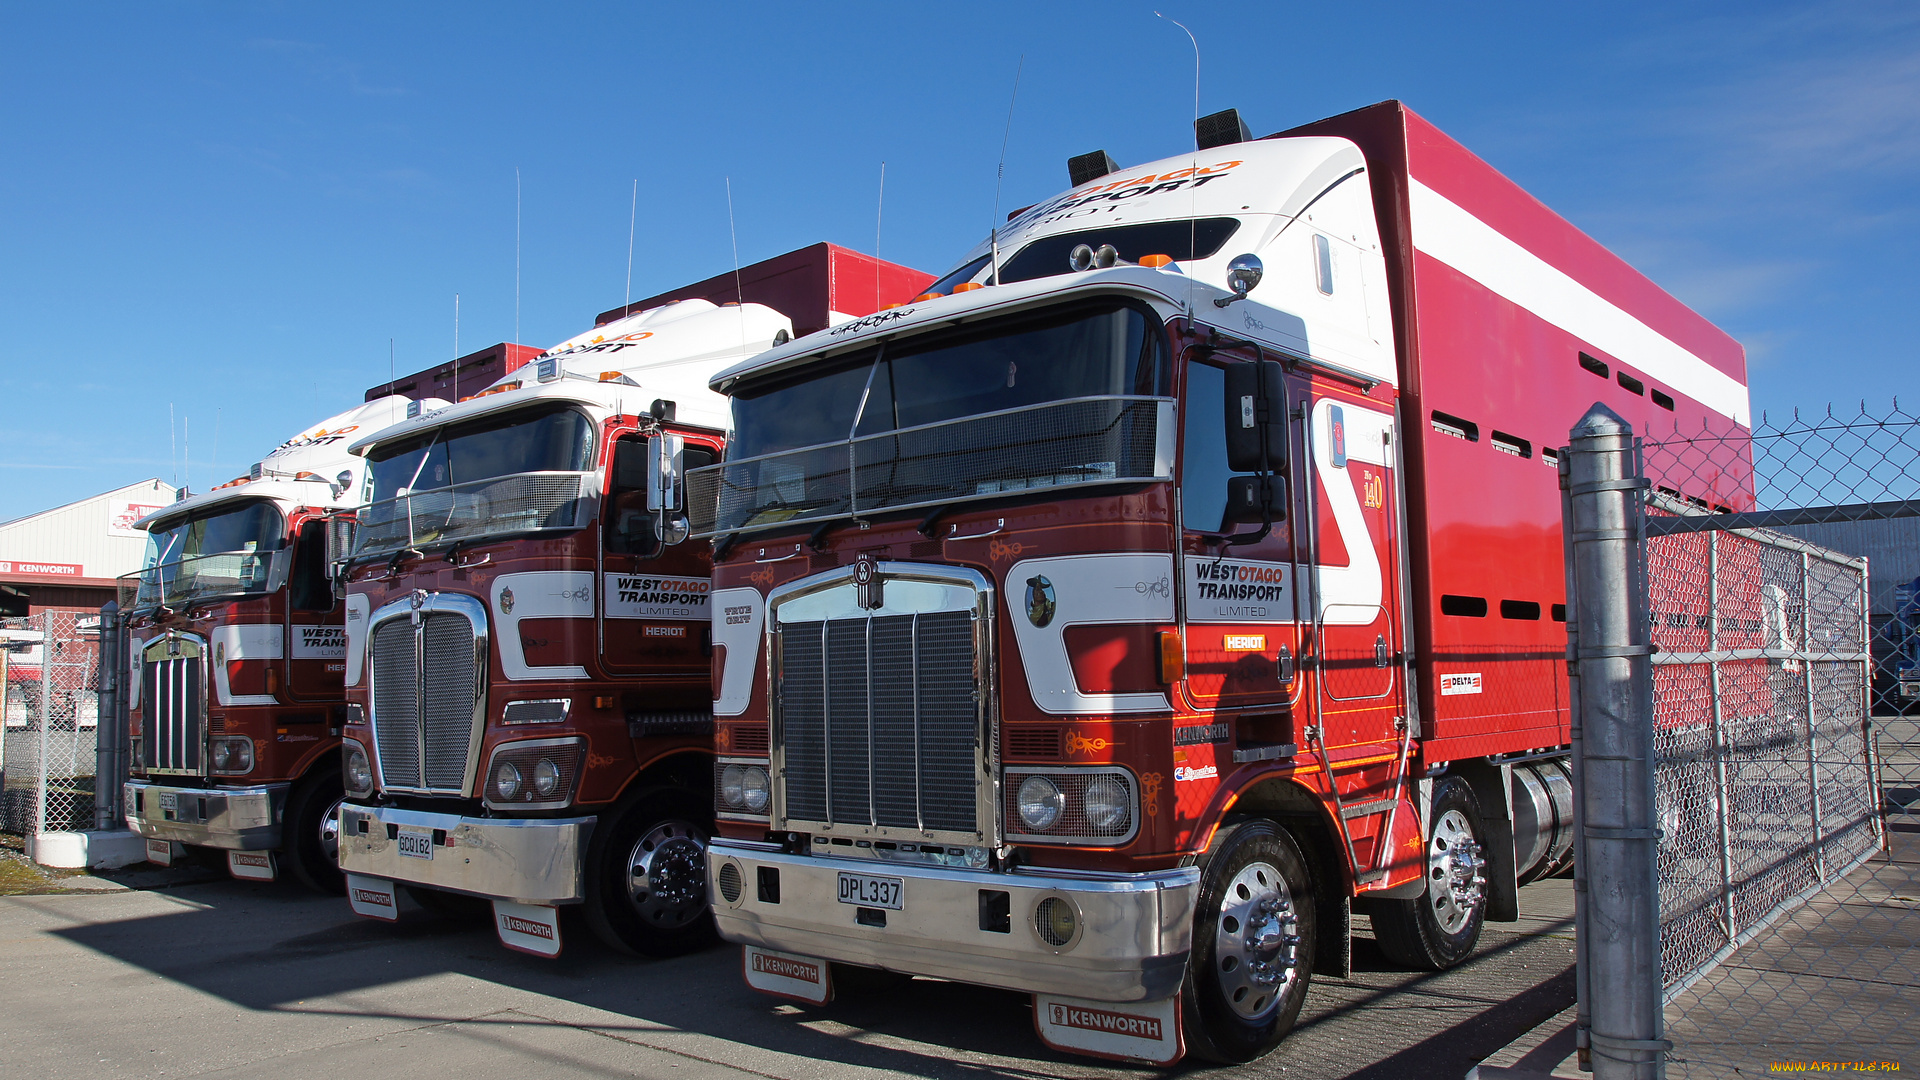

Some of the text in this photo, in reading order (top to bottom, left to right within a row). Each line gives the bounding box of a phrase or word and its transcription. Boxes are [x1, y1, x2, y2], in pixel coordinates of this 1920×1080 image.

[1364, 476, 1382, 508] 140
[19, 564, 75, 574] KENWORTH
[1196, 563, 1283, 583] WESTOTAGO
[617, 578, 709, 592] WESTOTAGO
[1198, 583, 1282, 602] TRANSPORT
[619, 591, 708, 605] TRANSPORT
[639, 607, 689, 616] LIMITED
[1219, 606, 1267, 617] LIMITED
[645, 627, 684, 636] HERIOT
[1227, 636, 1263, 649] HERIOT
[1452, 677, 1472, 685] DELTA
[1175, 723, 1229, 742] KENWORTH
[400, 836, 430, 854] GCQ162
[360, 892, 392, 905] KENWORTH
[840, 877, 900, 905] DPL337
[510, 922, 551, 938] KENWORTH
[765, 960, 817, 981] KENWORTH
[1070, 1010, 1159, 1037] KENWORTH
